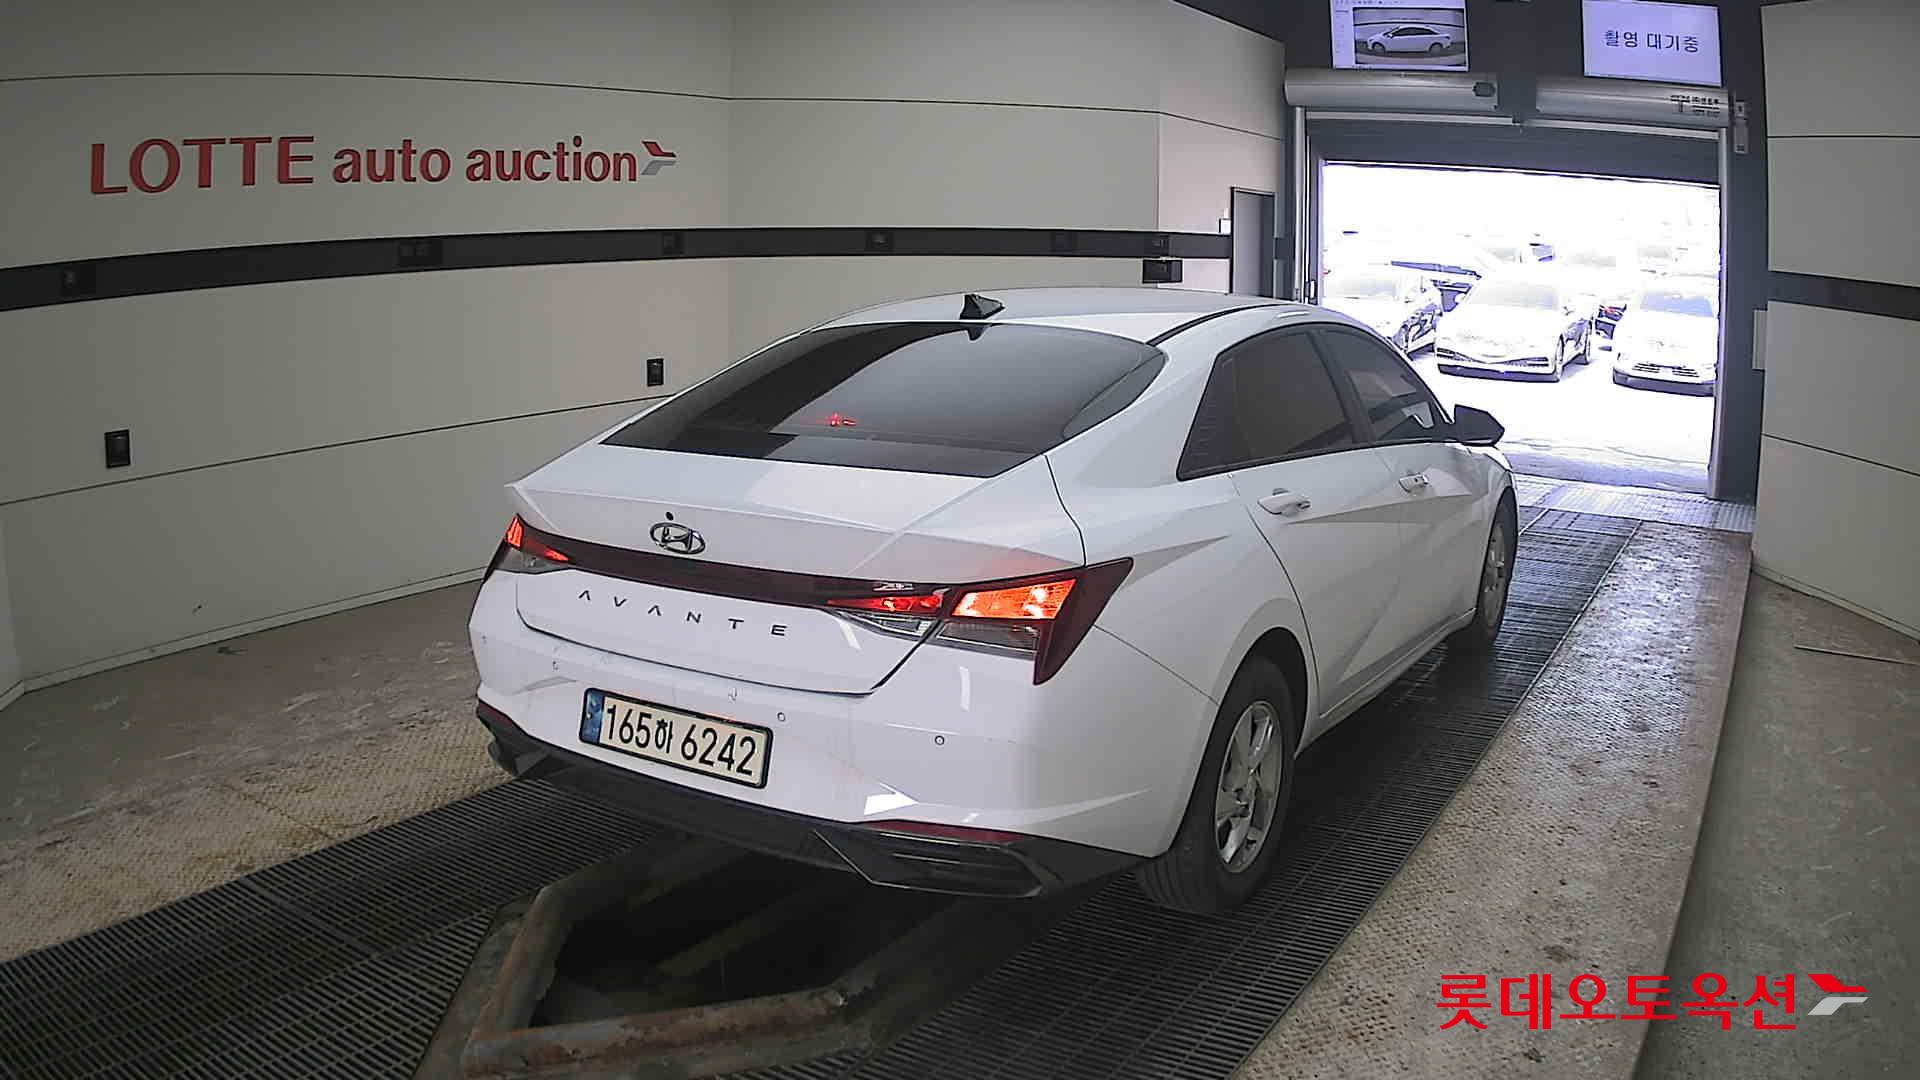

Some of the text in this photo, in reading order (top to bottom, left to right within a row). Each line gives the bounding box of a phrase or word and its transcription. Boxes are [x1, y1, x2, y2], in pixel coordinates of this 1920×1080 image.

[1646, 33, 1699, 53] 대기중
[90, 135, 638, 195] LOTTE auto auction
[578, 589, 788, 637] AVANTE
[606, 704, 757, 776] 165하 6242
